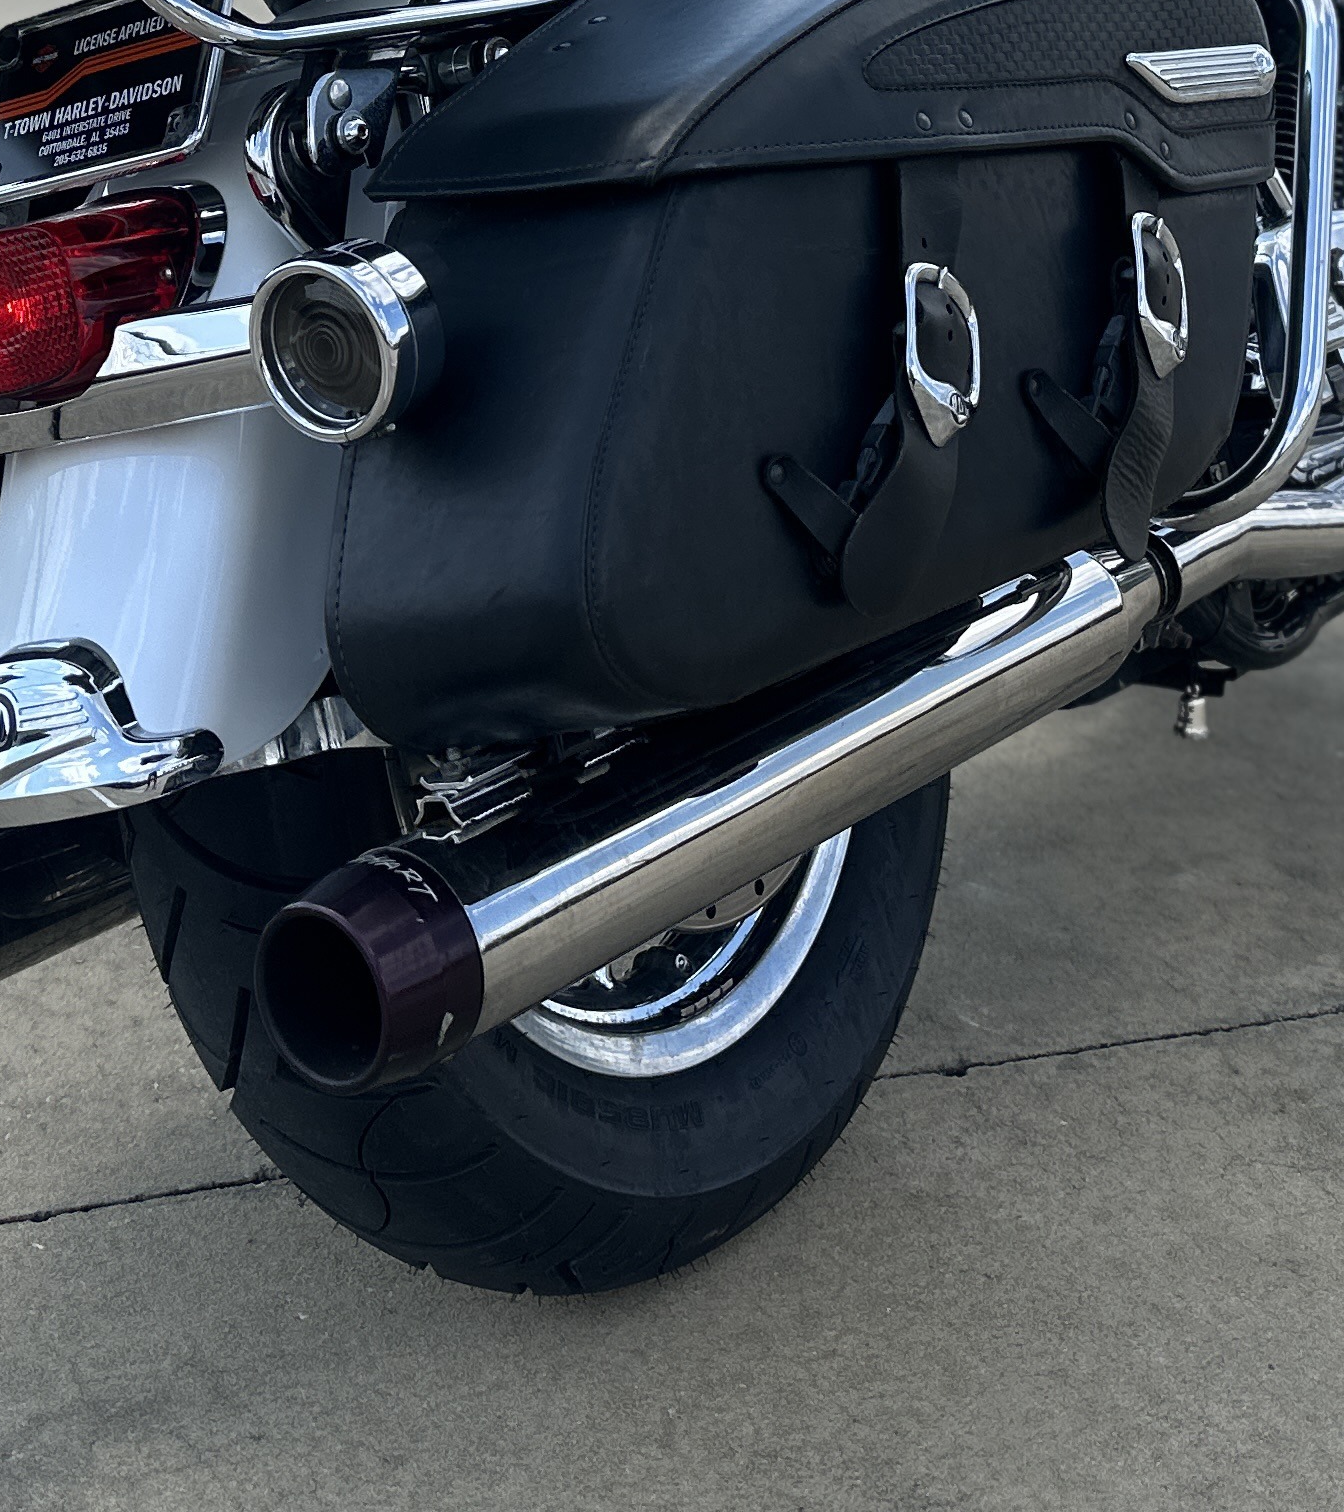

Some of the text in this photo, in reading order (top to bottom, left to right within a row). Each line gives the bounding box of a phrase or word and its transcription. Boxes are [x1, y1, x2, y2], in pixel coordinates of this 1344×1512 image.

[73, 15, 166, 56] LICENSE APPLIED
[3, 73, 184, 140] T-TOWN HARLEY-DAVIDSON
[41, 108, 133, 143] 6401 INTERSTATE DRIVE
[89, 130, 101, 143] AL
[103, 122, 131, 140] 35453
